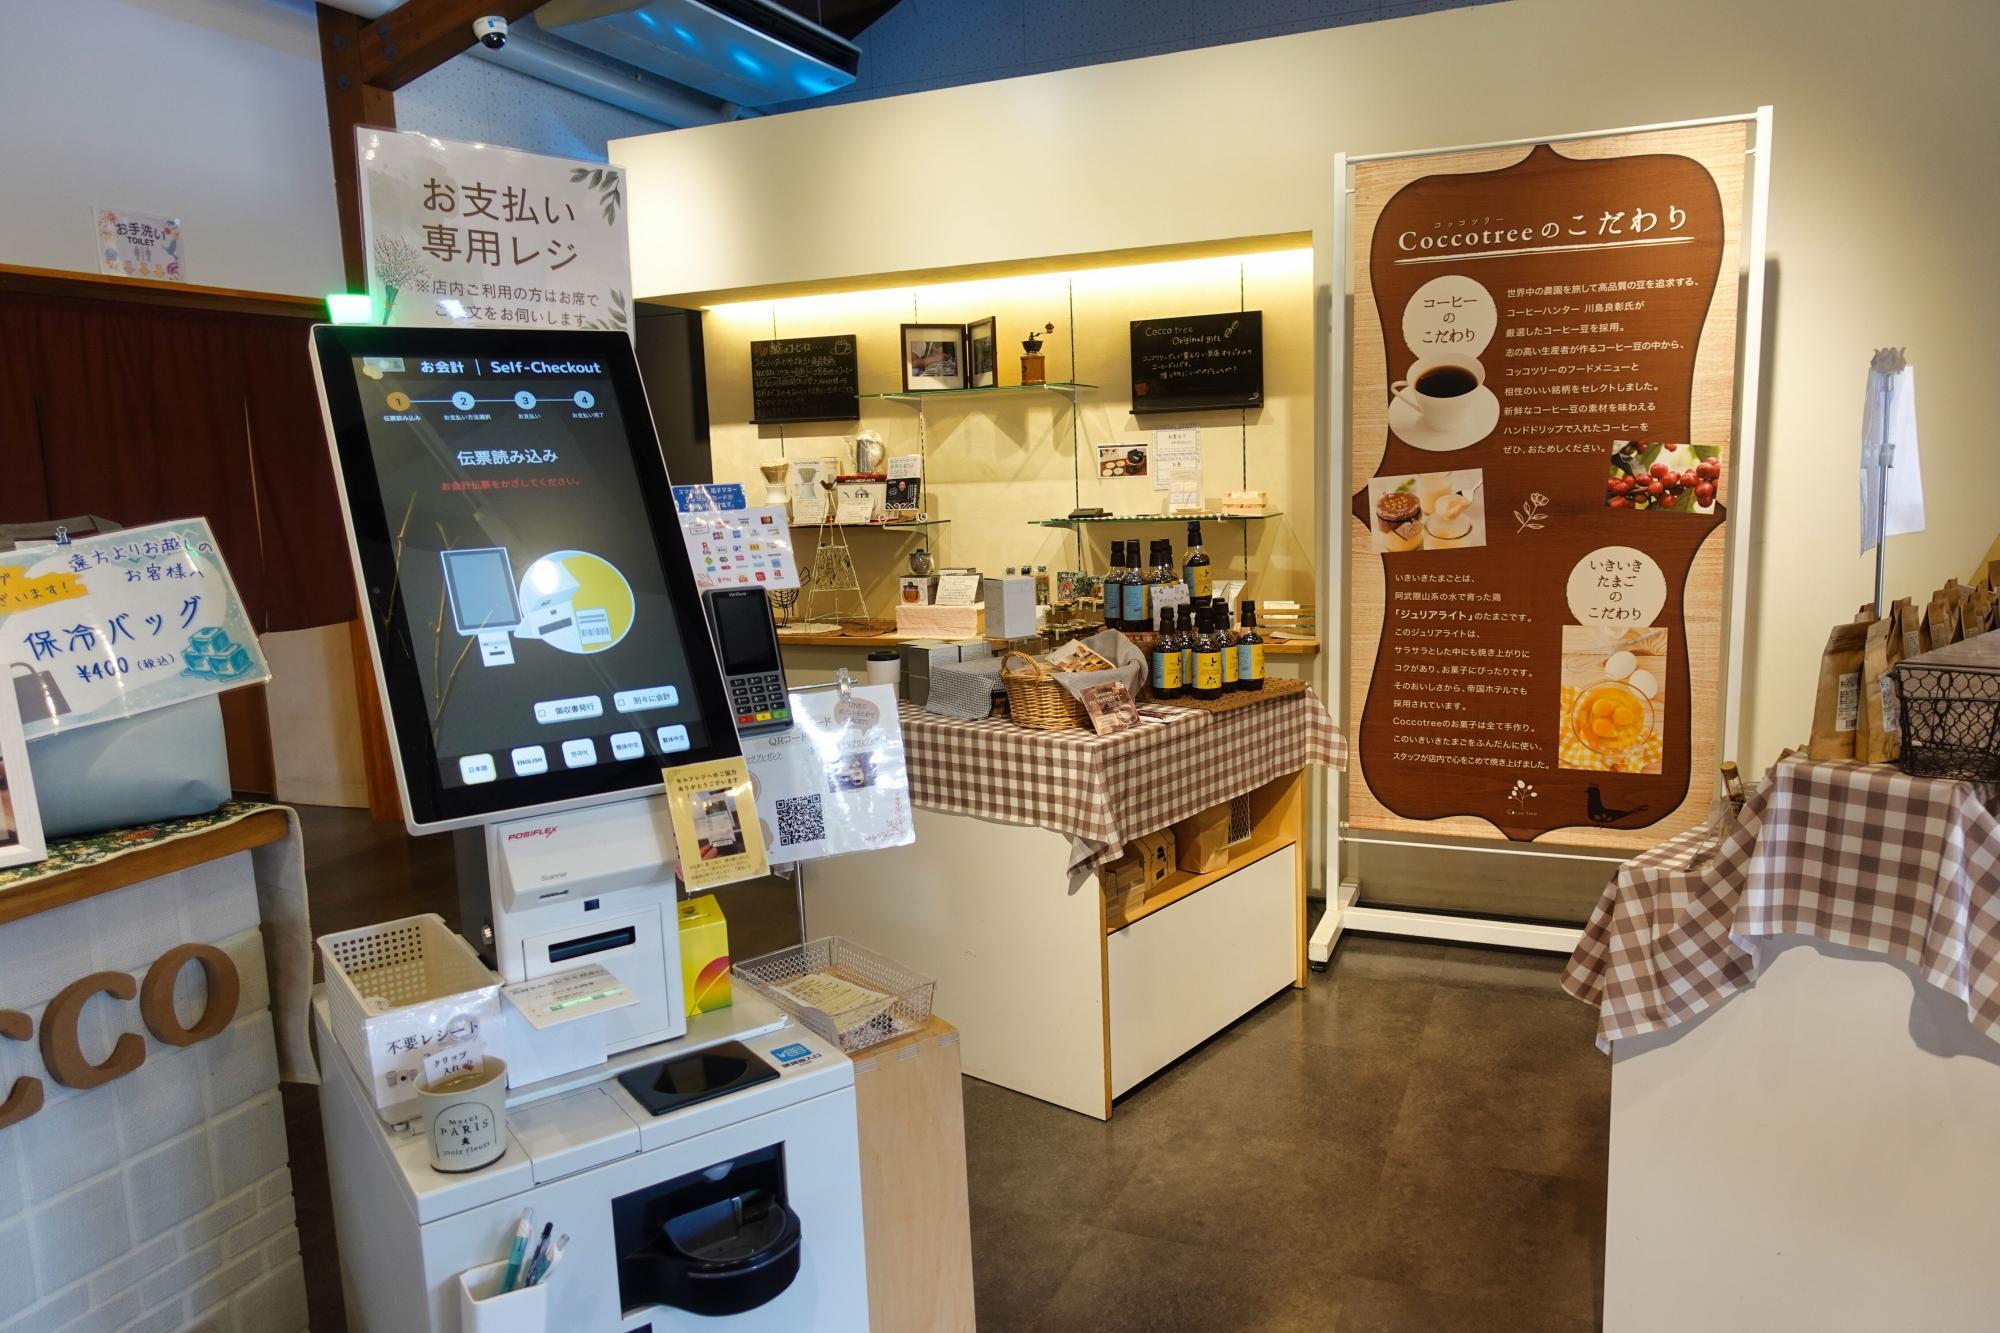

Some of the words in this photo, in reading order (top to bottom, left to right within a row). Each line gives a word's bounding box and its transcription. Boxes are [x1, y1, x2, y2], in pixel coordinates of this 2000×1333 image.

[423, 177, 576, 225] お支払い
[1433, 217, 1504, 229] コッコツリー
[116, 222, 166, 240] お手洗い
[127, 236, 155, 247] TOILET
[422, 224, 577, 271] 専用レジ
[1424, 296, 1478, 308] コーヒー
[436, 301, 587, 328] ご文をお伺いします
[1443, 312, 1456, 324] の
[1507, 306, 1580, 317] コーヒーハンター
[1422, 328, 1475, 343] こだわり
[421, 361, 464, 374] お会計
[490, 361, 602, 374] Self-Checkout
[1505, 362, 1639, 376] コッコツリーのフードメニューと
[457, 449, 558, 466] 伝票読み込み
[1590, 559, 1642, 572] いきいき
[1395, 574, 1476, 583] いきいきたまごとは、
[1597, 575, 1637, 588] たまご
[1609, 591, 1622, 602] の
[1588, 606, 1642, 621] こだわり
[24, 595, 202, 661] 保冷バッグ
[77, 657, 129, 682] ¥400
[517, 757, 543, 766] ENGLISH
[468, 765, 488, 774] 日本語
[508, 826, 558, 840] POSIFLEX
[541, 872, 567, 882] Scanner
[386, 1021, 478, 1055] 不要レシート
[434, 1051, 467, 1067] クリップ
[440, 1118, 488, 1136] PARIS
